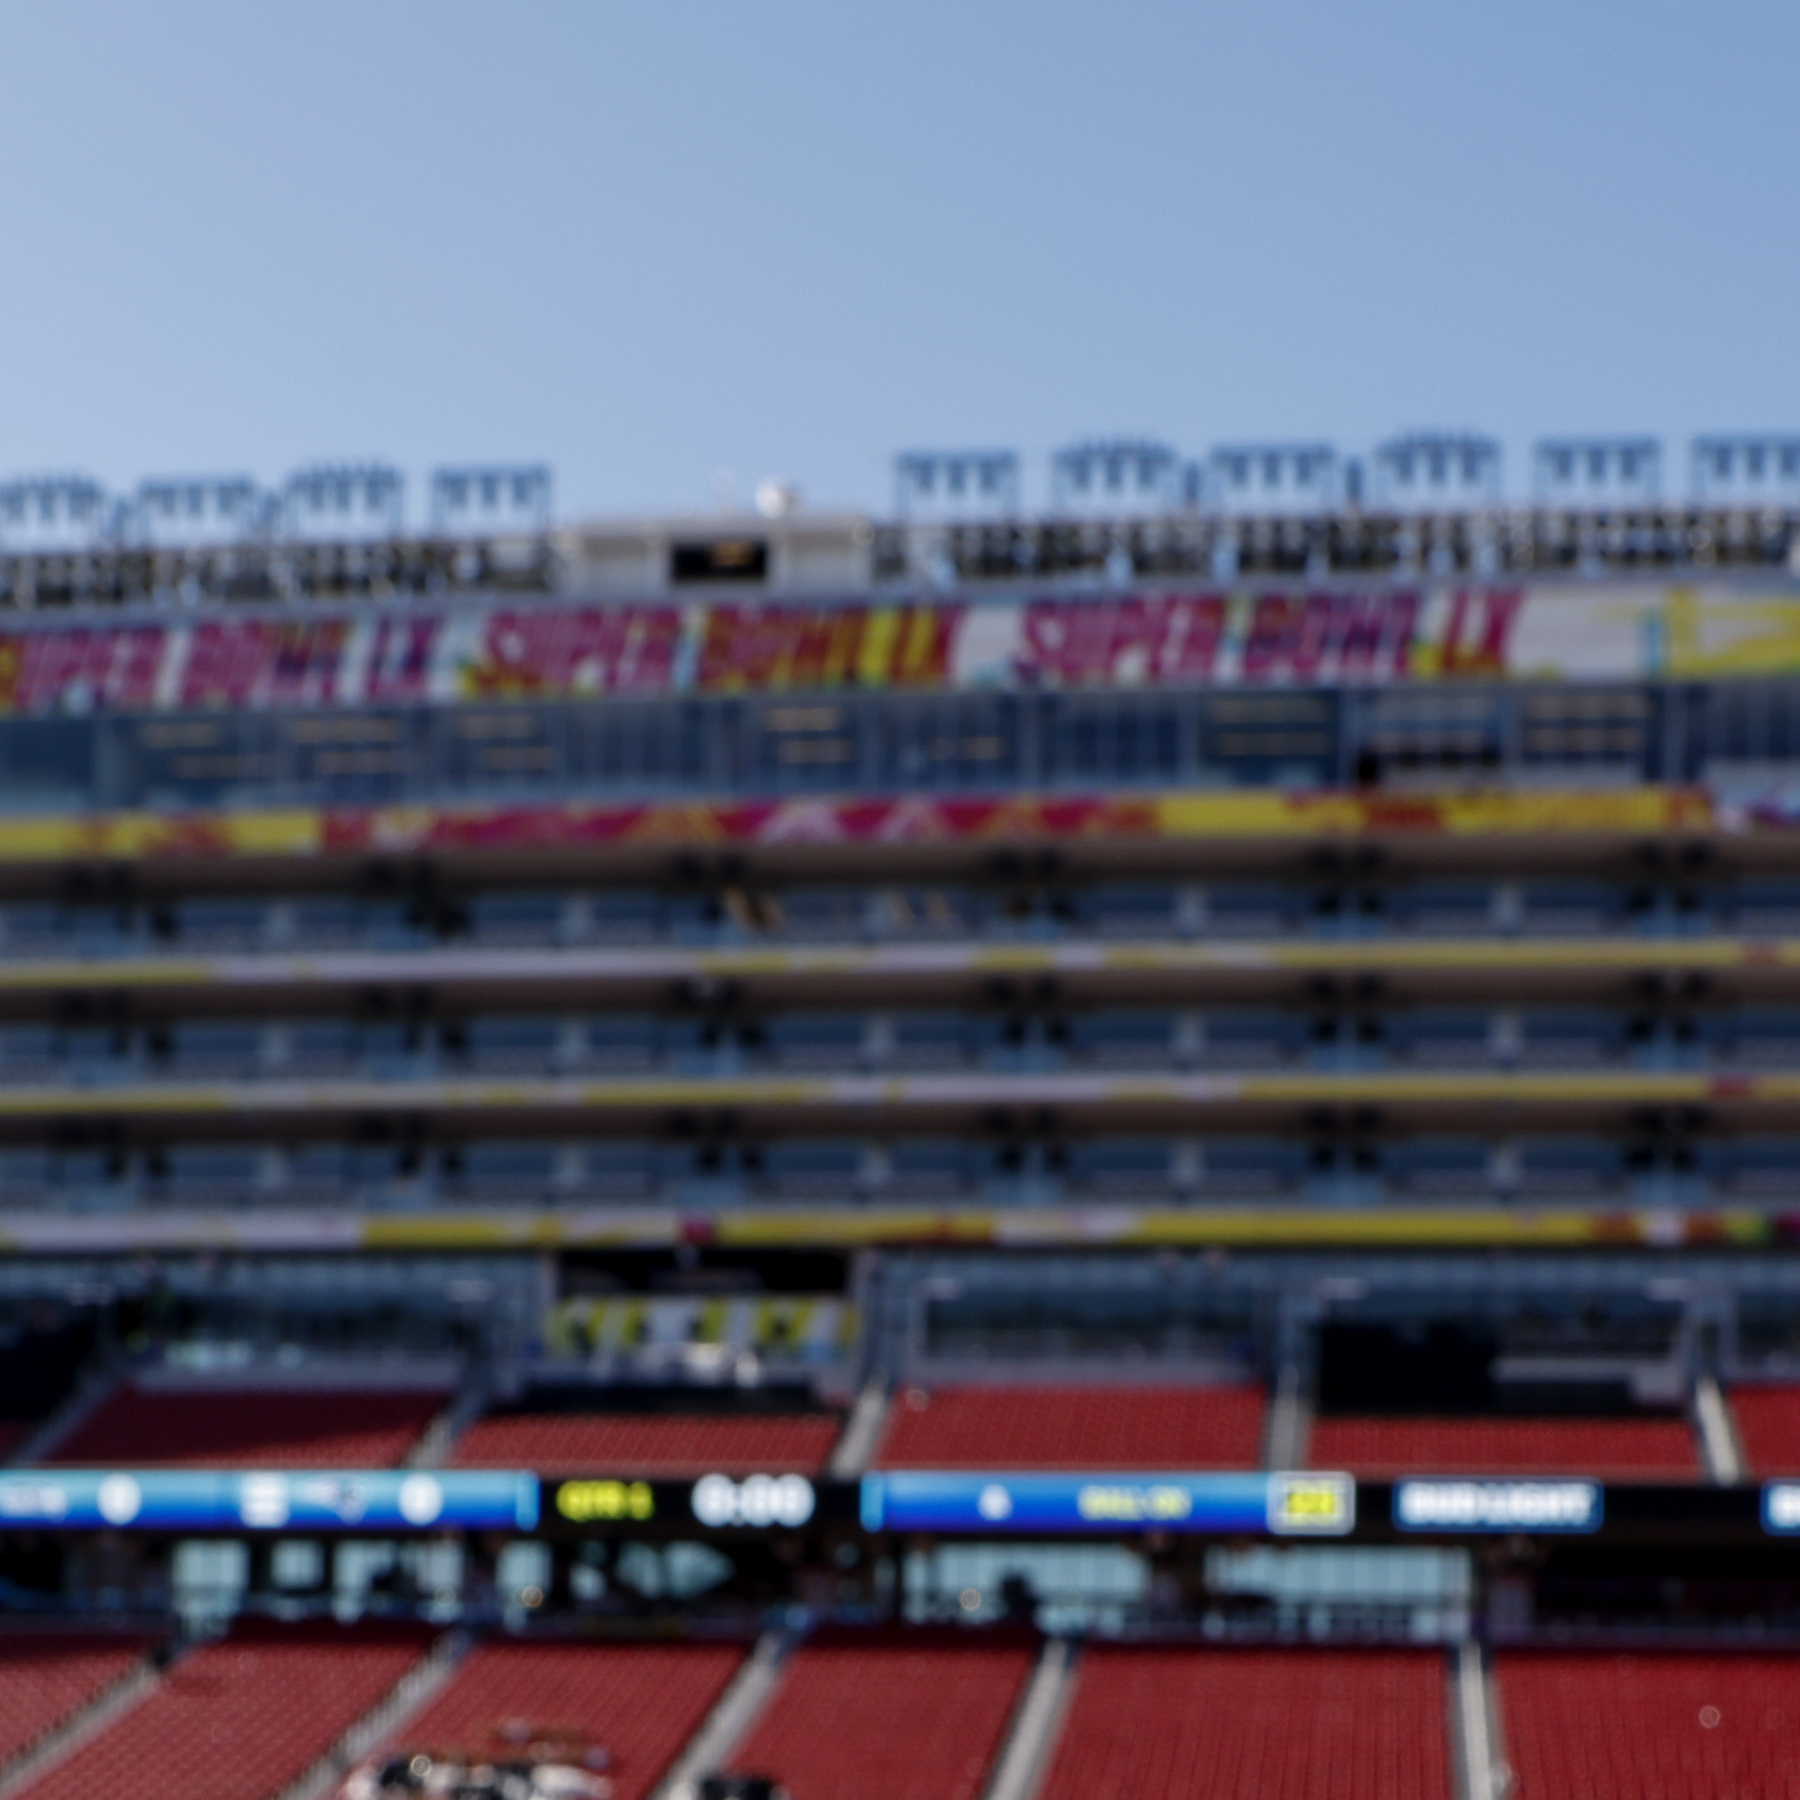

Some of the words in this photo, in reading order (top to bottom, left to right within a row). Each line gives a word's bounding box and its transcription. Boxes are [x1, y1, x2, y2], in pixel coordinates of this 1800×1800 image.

[178, 614, 360, 705] BOWL
[362, 611, 446, 700] LX
[468, 611, 684, 696] SUPER
[697, 606, 872, 692] BOWL
[880, 603, 967, 688] LX
[1012, 597, 1228, 686] SUPER
[1240, 590, 1422, 679] BOWL
[1436, 586, 1526, 674] LX
[695, 1476, 811, 1524] 0:00
[1404, 1483, 1484, 1521] BUD
[1485, 1483, 1590, 1521] LIGHT
